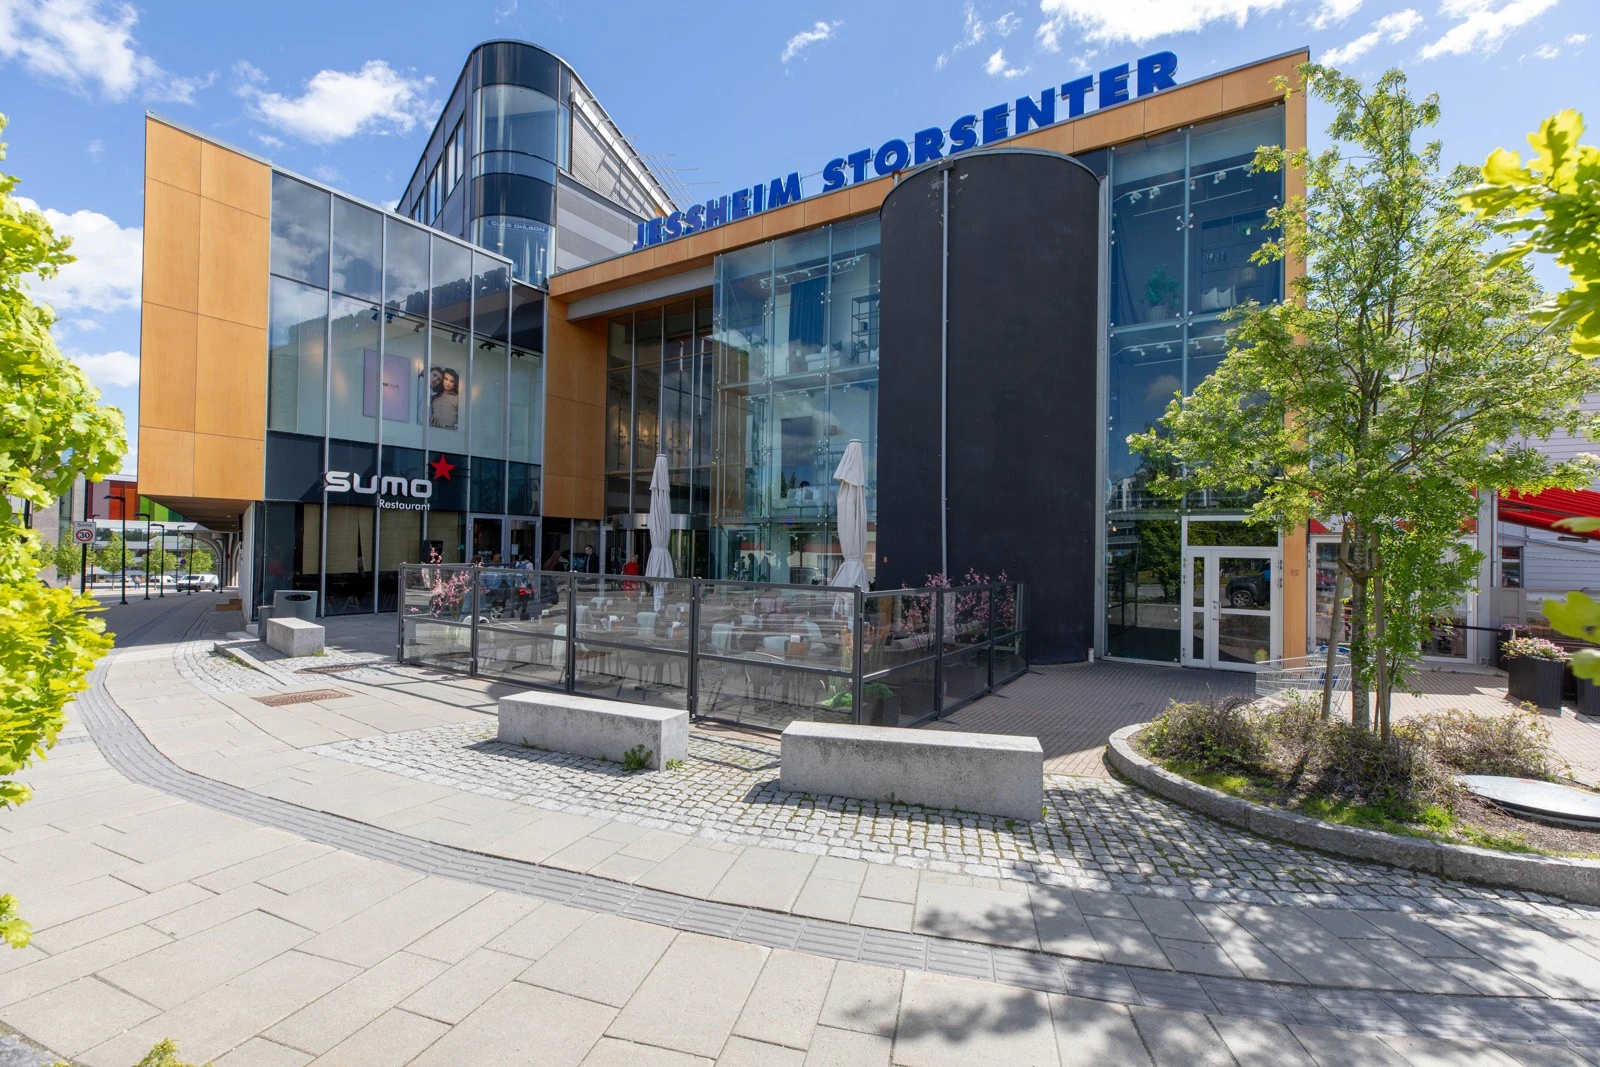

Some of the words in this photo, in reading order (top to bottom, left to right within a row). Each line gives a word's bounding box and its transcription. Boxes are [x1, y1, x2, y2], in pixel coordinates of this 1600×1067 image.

[632, 171, 803, 250] JESSHEIM
[822, 51, 1178, 192] STORSENTER
[491, 220, 512, 228] CLAS
[513, 223, 546, 232] OHLSON
[379, 498, 431, 511] Restaurant
[79, 531, 91, 539] 30
